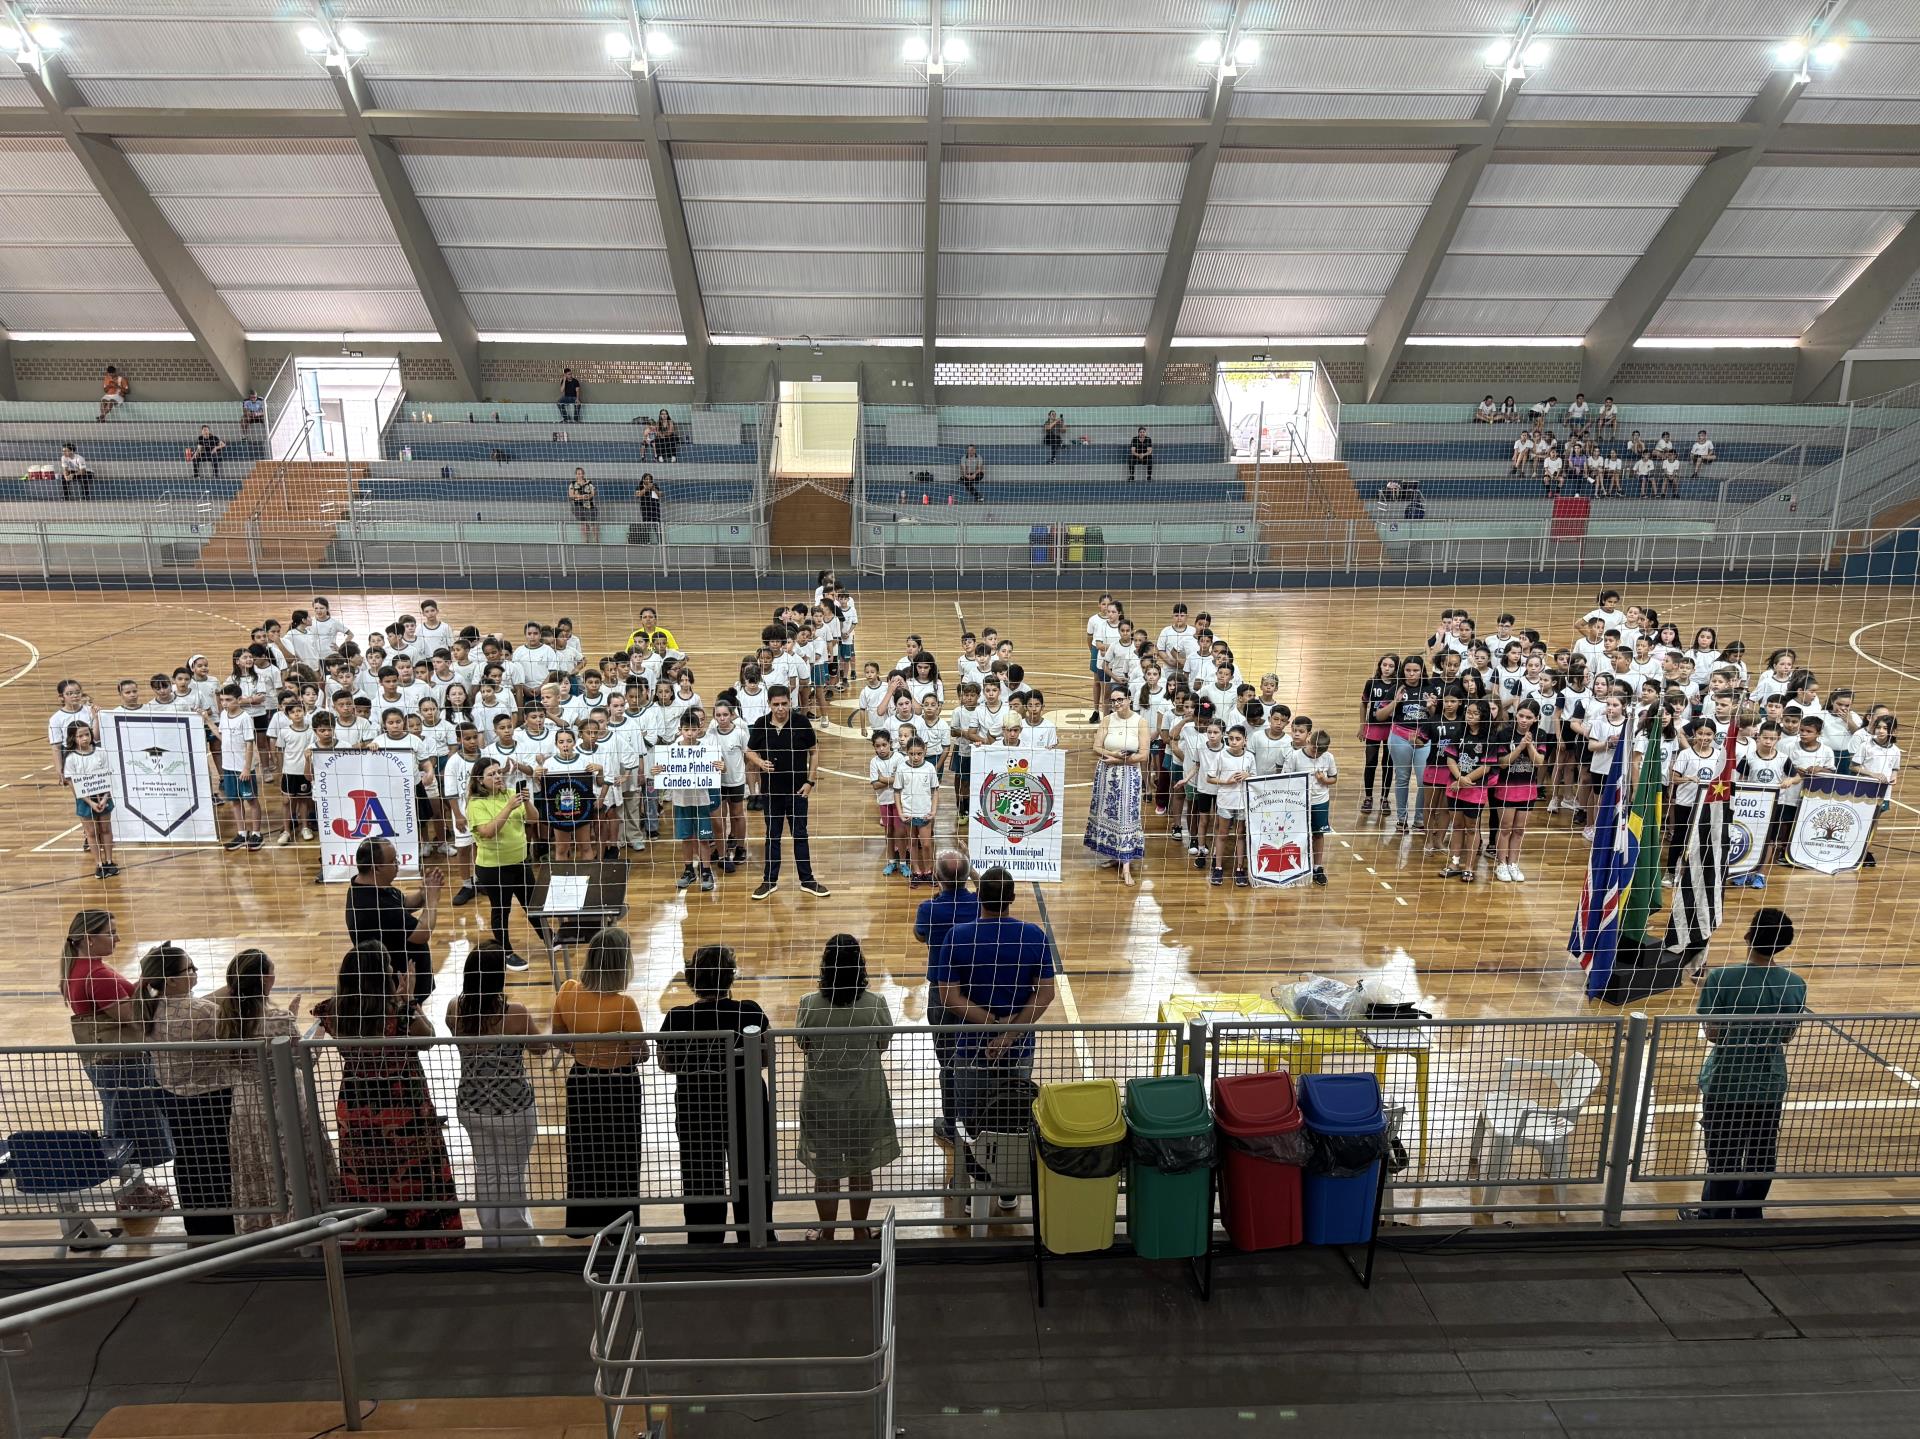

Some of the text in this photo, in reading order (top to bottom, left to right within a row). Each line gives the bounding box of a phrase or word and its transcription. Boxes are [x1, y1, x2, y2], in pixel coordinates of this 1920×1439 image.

[1373, 687, 1383, 698] 10
[1402, 692, 1409, 701] 9
[1437, 725, 1447, 736] 11
[671, 748, 687, 759] E.M.
[324, 750, 368, 769] ARNALDO
[371, 750, 408, 774] ANDREU
[656, 762, 687, 773] acema
[663, 776, 691, 787] Candeo
[697, 776, 713, 787] Lola
[321, 796, 329, 819] PROF
[403, 777, 413, 835] AVELHANEDA
[1737, 809, 1767, 818] JALES
[323, 820, 330, 828] M
[984, 845, 1044, 859] Escola Municipal
